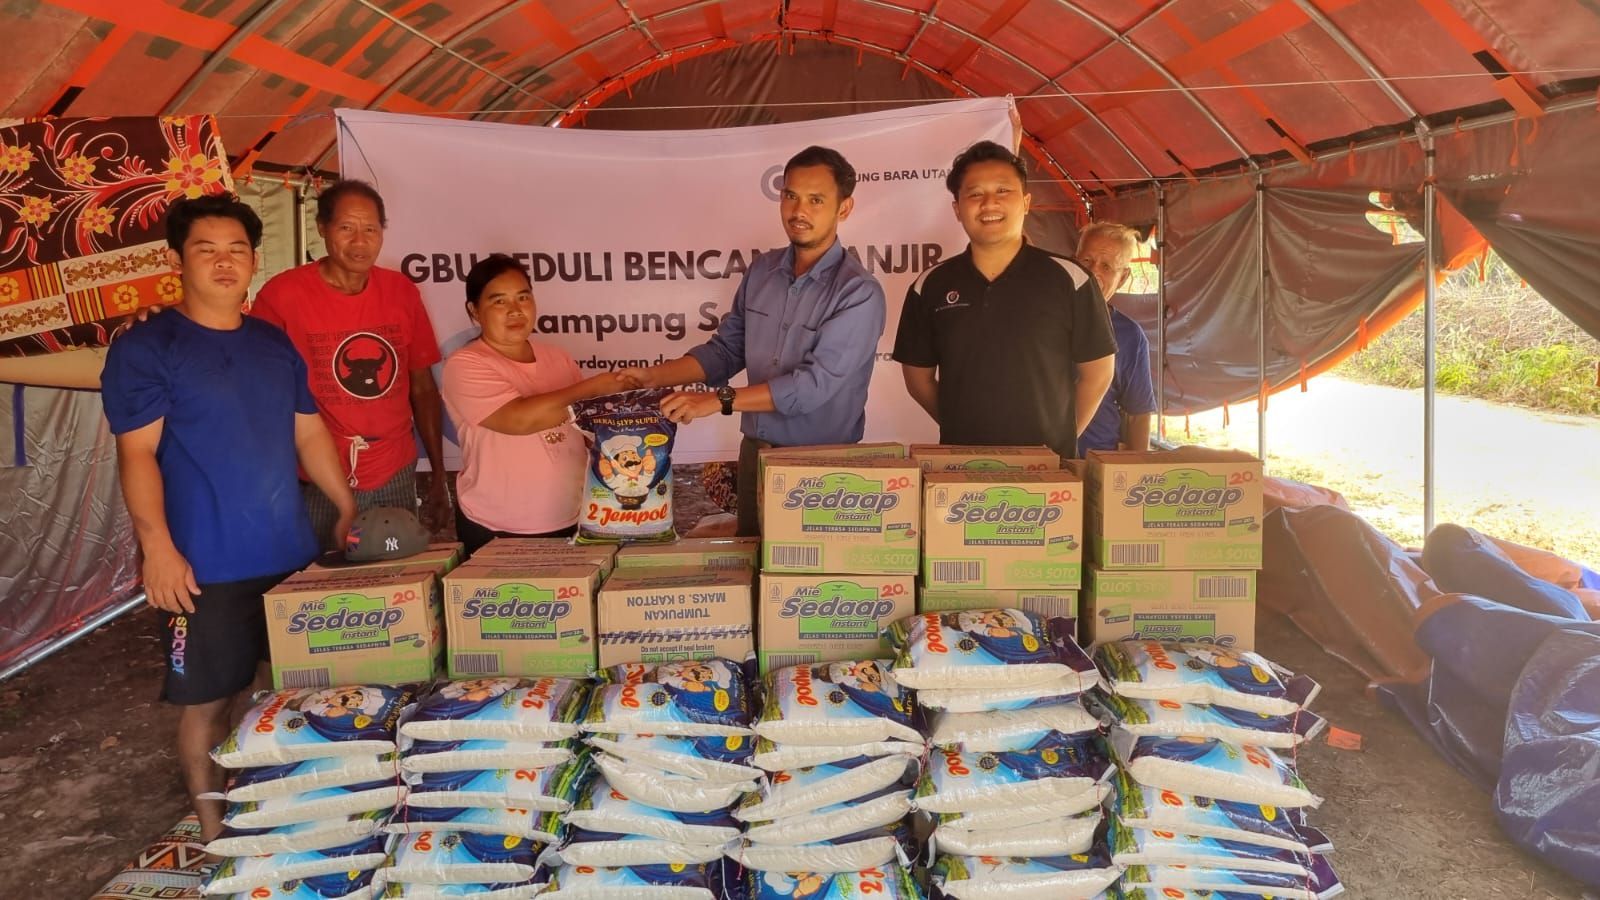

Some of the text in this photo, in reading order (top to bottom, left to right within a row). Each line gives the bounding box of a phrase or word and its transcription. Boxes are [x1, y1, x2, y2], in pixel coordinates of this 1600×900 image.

[883, 170, 919, 180] BARA
[922, 168, 951, 179] UTA
[400, 252, 477, 283] GBU
[489, 251, 613, 282] EDULI
[624, 249, 775, 281] BENCA
[531, 309, 686, 342] ampung
[575, 354, 649, 373] rdayaan
[799, 478, 825, 488] Mie
[886, 476, 909, 491] 20
[1140, 474, 1168, 486] Mie
[1229, 471, 1253, 485] 20
[783, 488, 899, 513] Sedaap
[959, 491, 987, 503] Mie
[1048, 490, 1072, 505] 20
[1123, 484, 1243, 511] Sedaap
[587, 502, 669, 527] 2 Jempol
[945, 501, 1062, 528] Sedaap
[392, 590, 416, 605] 20
[474, 588, 500, 599] Mie
[558, 586, 580, 600] 20
[795, 586, 821, 596] Mie
[880, 583, 904, 598] 20
[300, 600, 327, 612] Mie
[626, 592, 726, 608] MAKS. 8 KARTON
[462, 597, 571, 622] Sedaap
[644, 607, 711, 621] TUMPUKAN
[779, 597, 895, 620] Sedaap
[287, 607, 404, 634] Sedaap
